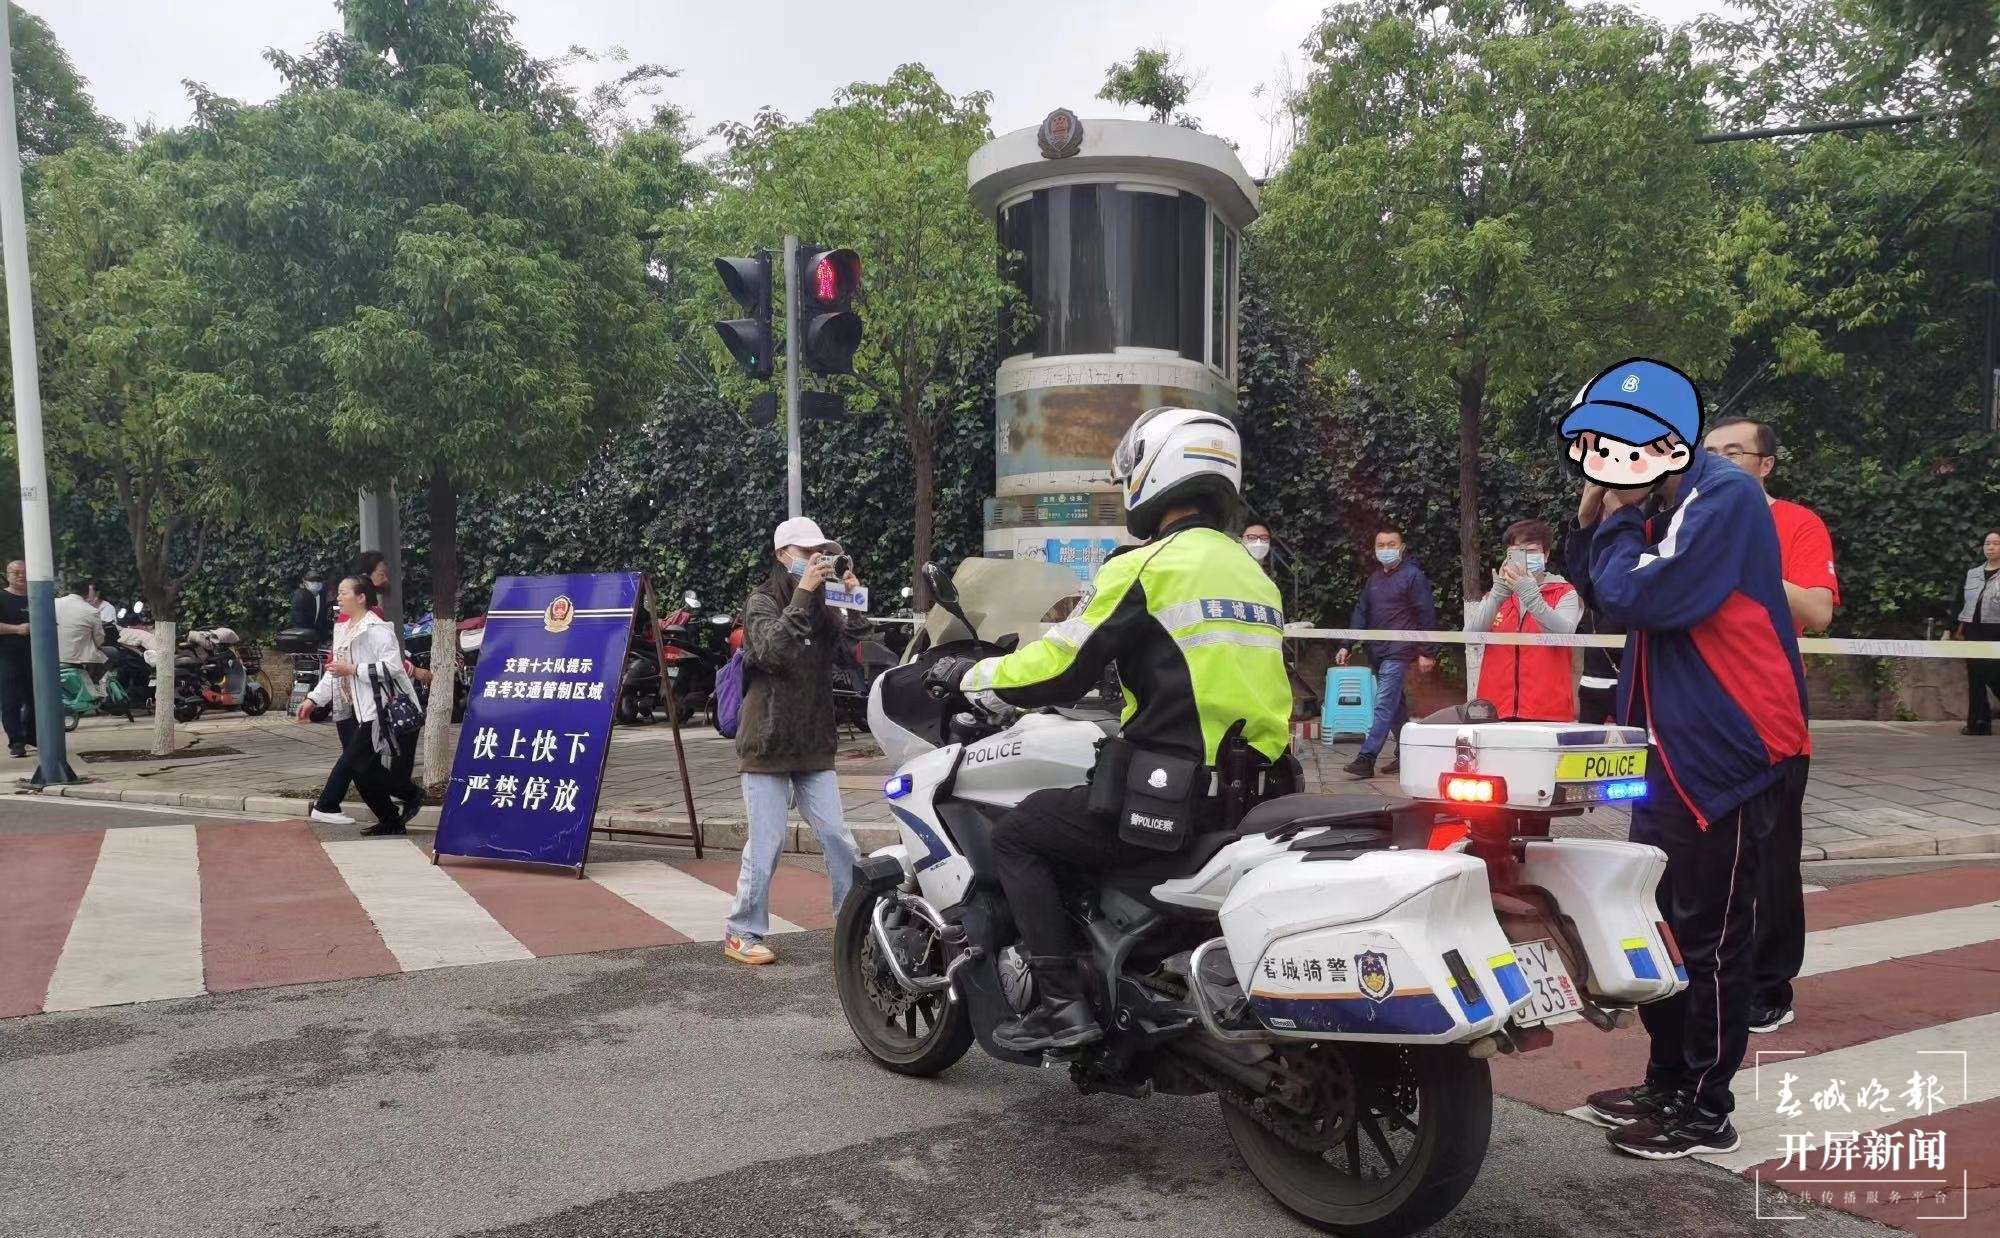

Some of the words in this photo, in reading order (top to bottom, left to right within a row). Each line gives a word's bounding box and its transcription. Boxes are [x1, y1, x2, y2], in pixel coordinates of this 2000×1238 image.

[504, 657, 593, 674] 交警十大队提示
[483, 680, 605, 700] 高考交通管制区域
[473, 726, 590, 763] 快上快下
[966, 741, 1022, 766] POLICE
[1585, 755, 1635, 778] POLICE
[461, 773, 580, 813] 严禁停放
[1264, 957, 1348, 982] 春城骑警
